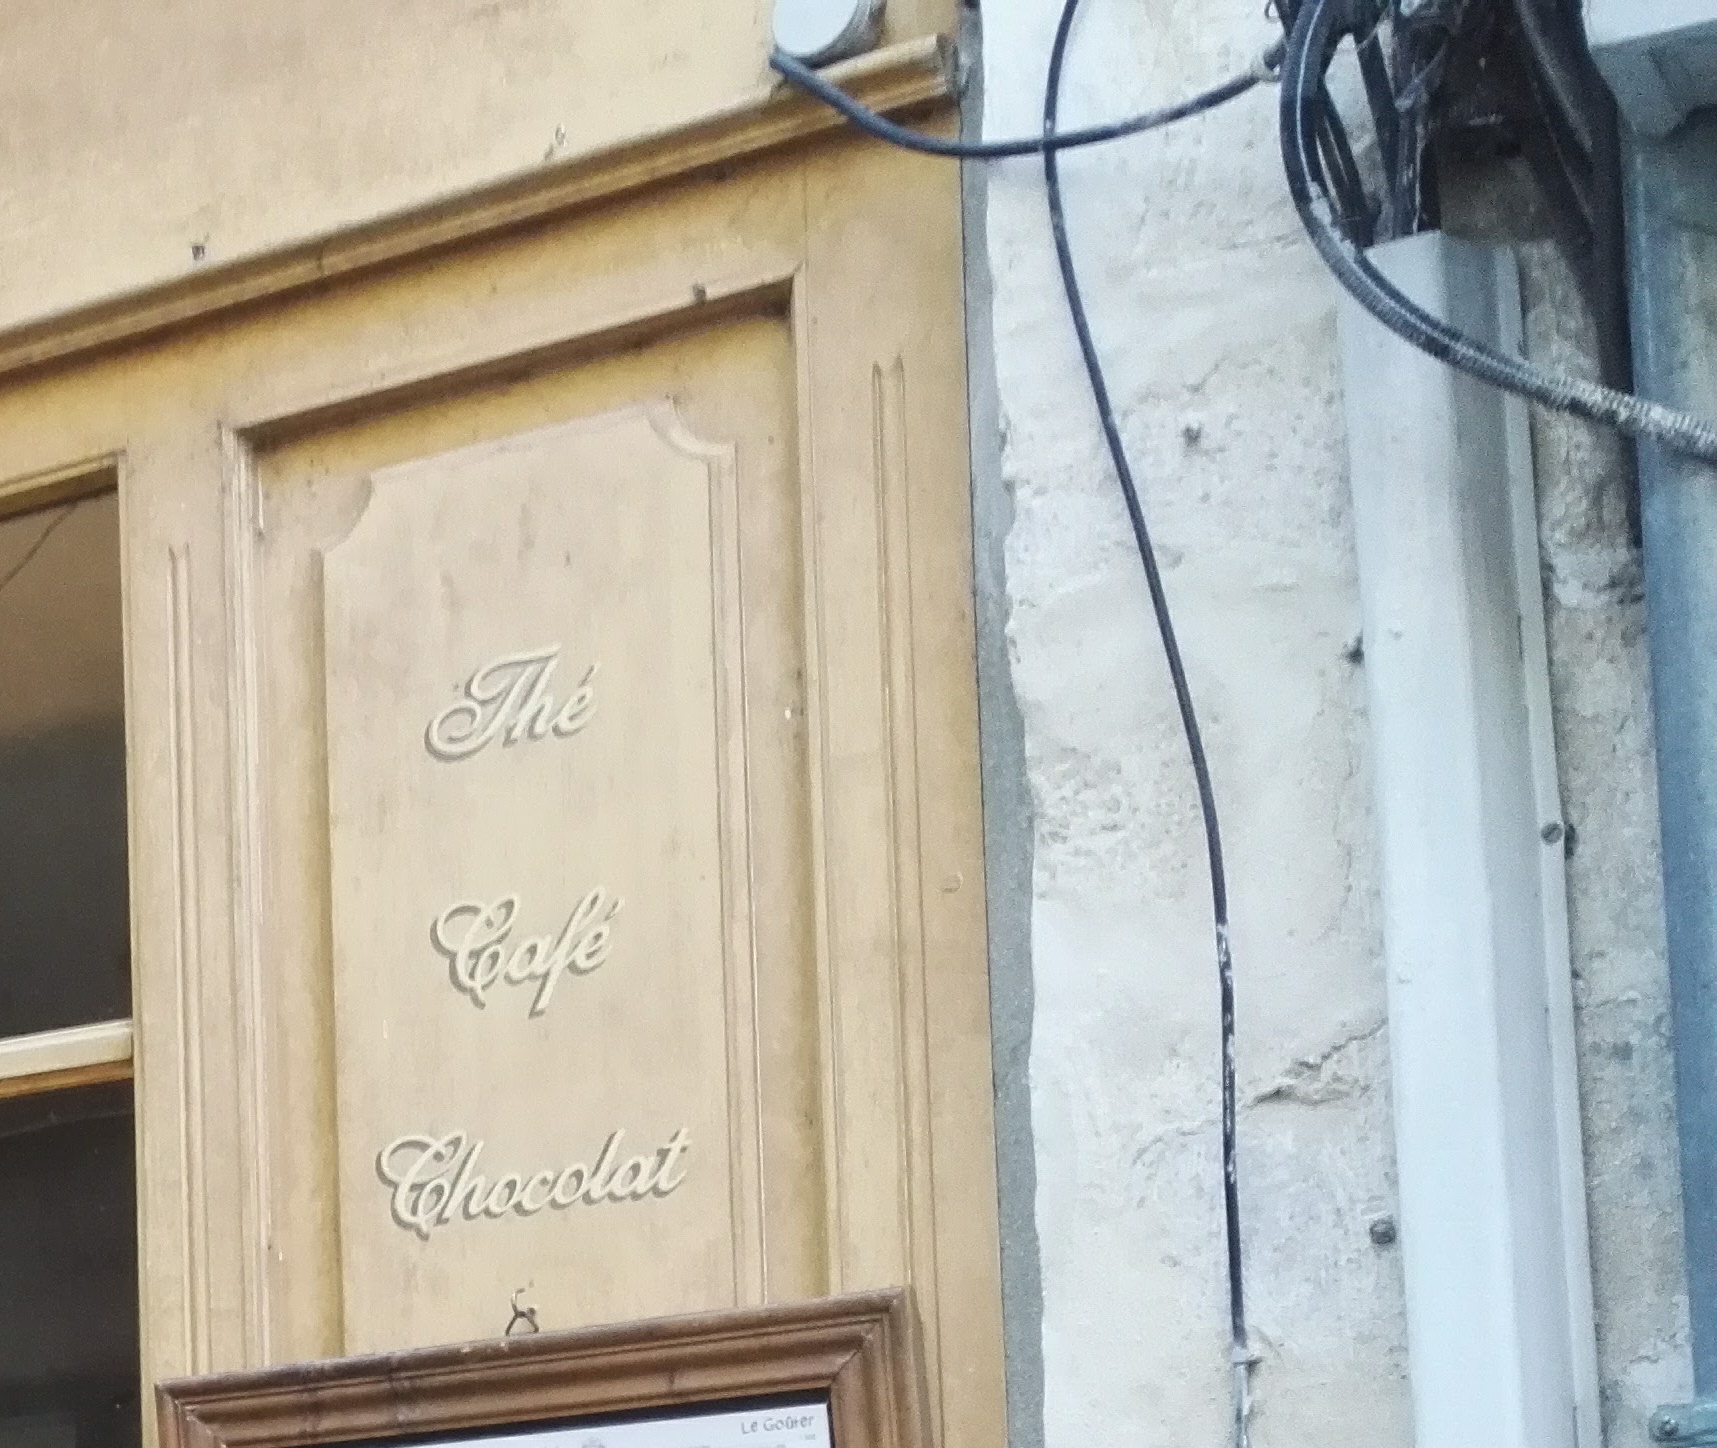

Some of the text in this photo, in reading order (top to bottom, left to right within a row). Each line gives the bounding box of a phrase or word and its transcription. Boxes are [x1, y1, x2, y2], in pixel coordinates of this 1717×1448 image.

[425, 642, 600, 760] Thé
[431, 886, 625, 1018] Café
[377, 1128, 692, 1240] Chocolat
